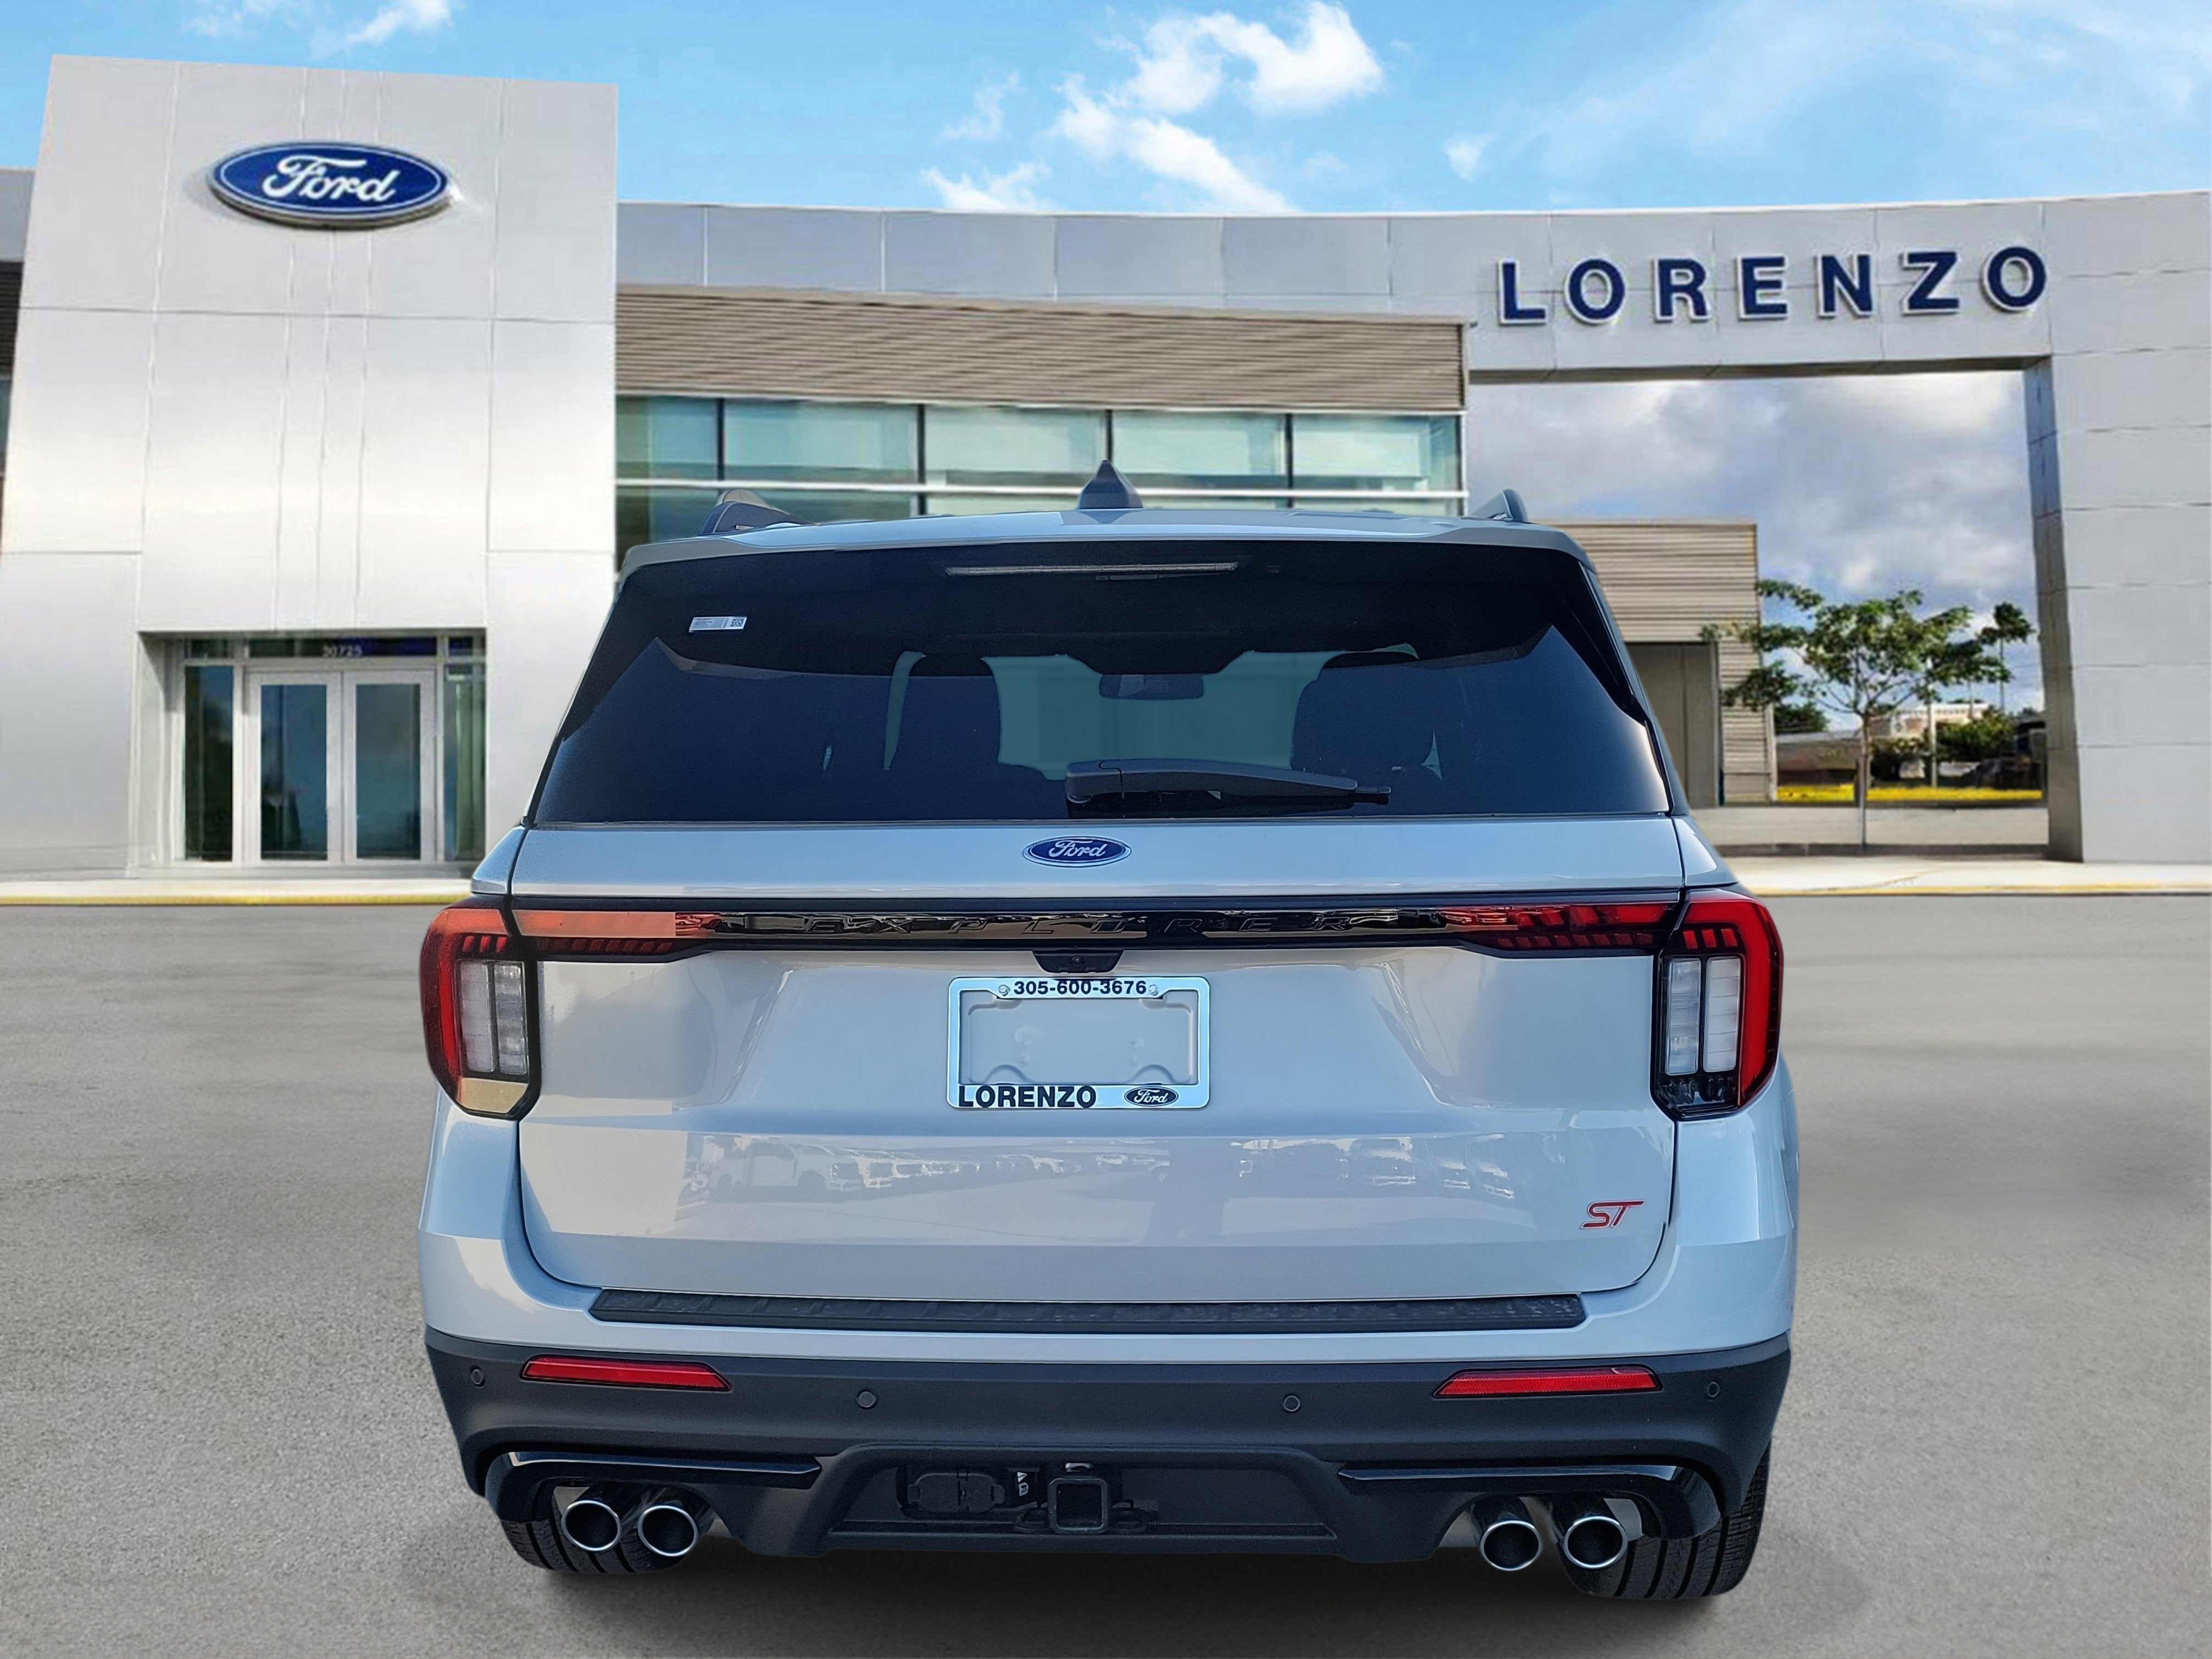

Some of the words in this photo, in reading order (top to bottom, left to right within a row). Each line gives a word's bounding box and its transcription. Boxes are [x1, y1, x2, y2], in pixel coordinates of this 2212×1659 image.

[262, 154, 400, 202] Ford
[1499, 246, 2047, 325] LORENZO
[1048, 839, 1108, 858] Ford
[805, 917, 1351, 934] EXPLORER
[1014, 981, 1147, 995] 305-600-3676
[958, 1085, 1097, 1109] LORENZO
[1133, 1090, 1168, 1104] Ford
[1580, 1200, 1646, 1229] ST
